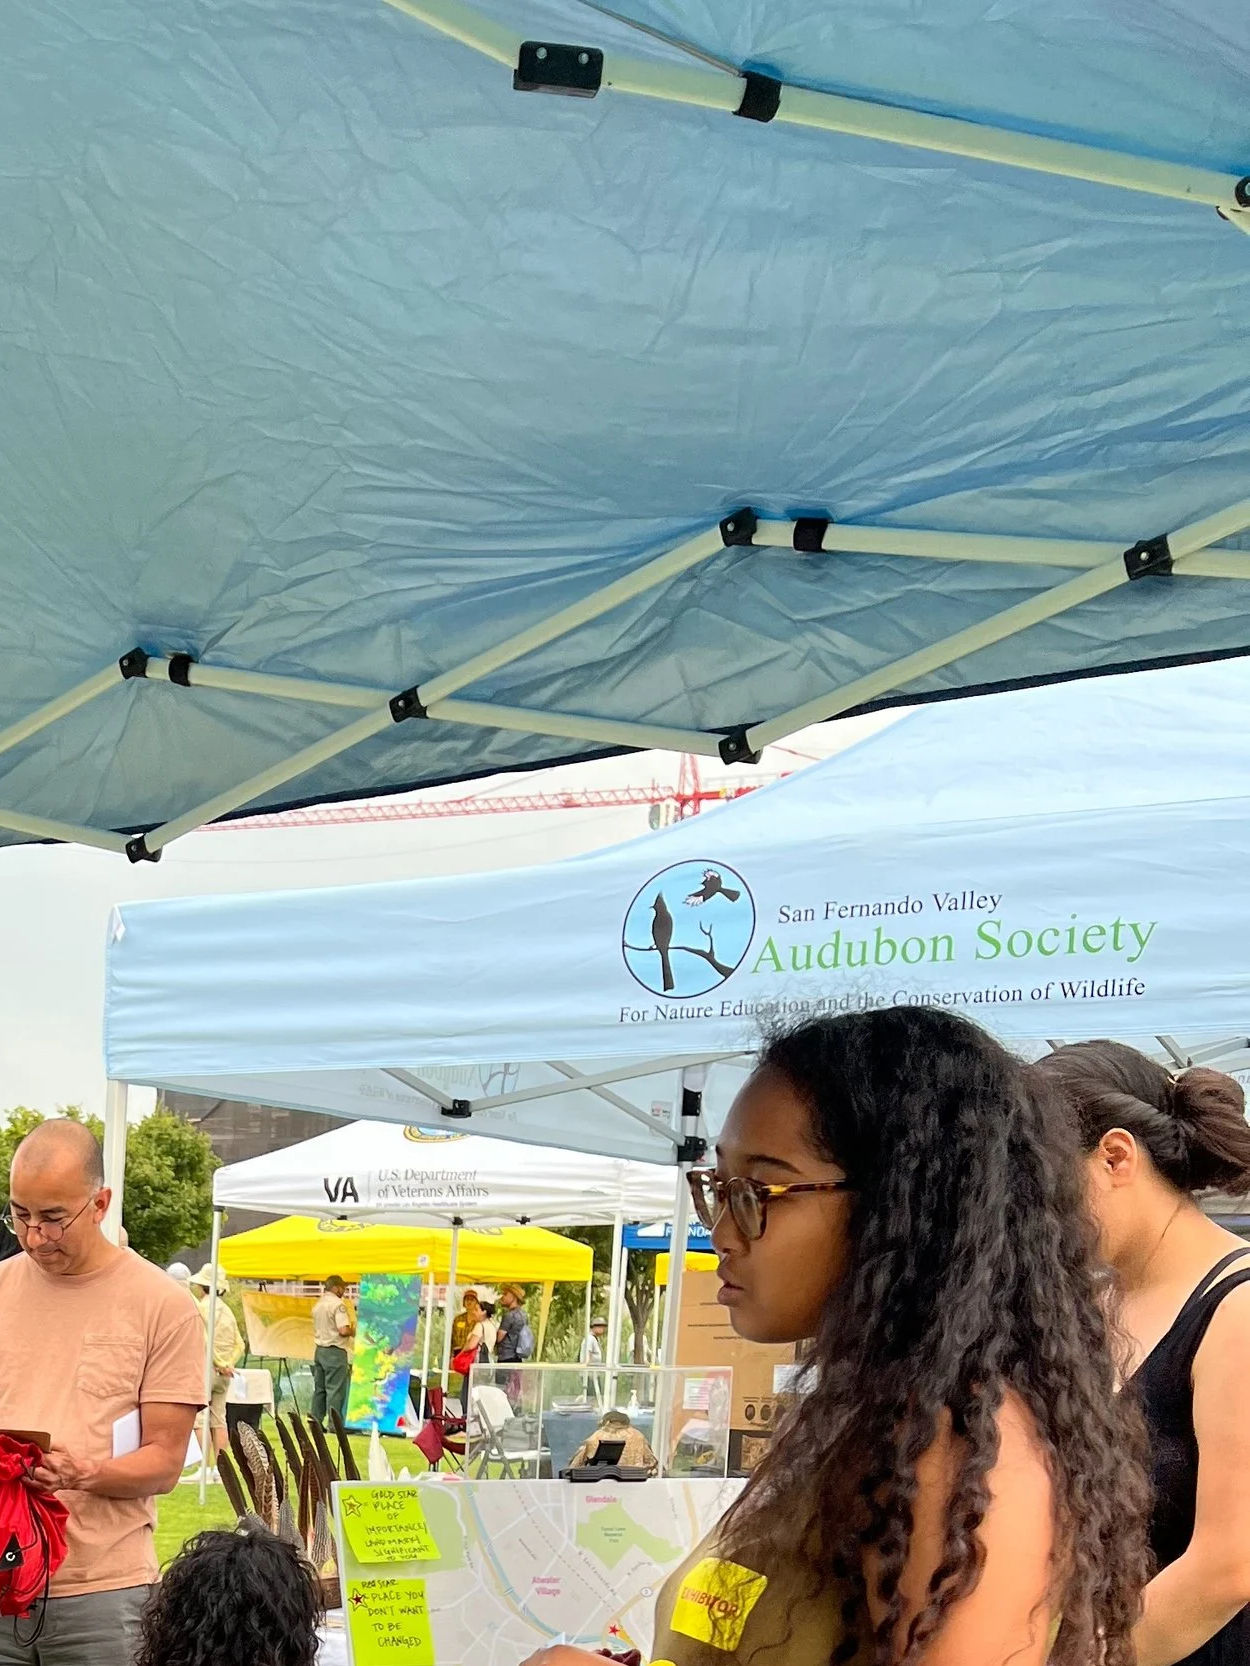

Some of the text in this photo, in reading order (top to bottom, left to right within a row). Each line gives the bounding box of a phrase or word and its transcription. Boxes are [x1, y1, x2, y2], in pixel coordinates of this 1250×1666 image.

[778, 890, 1003, 924] San Fernando Valley
[751, 913, 1158, 974] Audubon Society
[619, 977, 1146, 1023] For Nature Education and the Conservation of Wildlife
[378, 1168, 477, 1184] U.S. Department
[324, 1176, 359, 1203] VA
[377, 1184, 490, 1198] of Veterans Affairs
[371, 1489, 418, 1499] GOLD STAR
[373, 1501, 406, 1511] PLACE
[377, 1578, 398, 1589] STAR
[531, 1575, 561, 1585] Atwater
[371, 1590, 424, 1601] PLACE YOU
[534, 1586, 561, 1597] Village
[367, 1605, 424, 1616] DON'T WANT
[371, 1622, 402, 1632] TO BE
[378, 1636, 421, 1648] CHANGED
